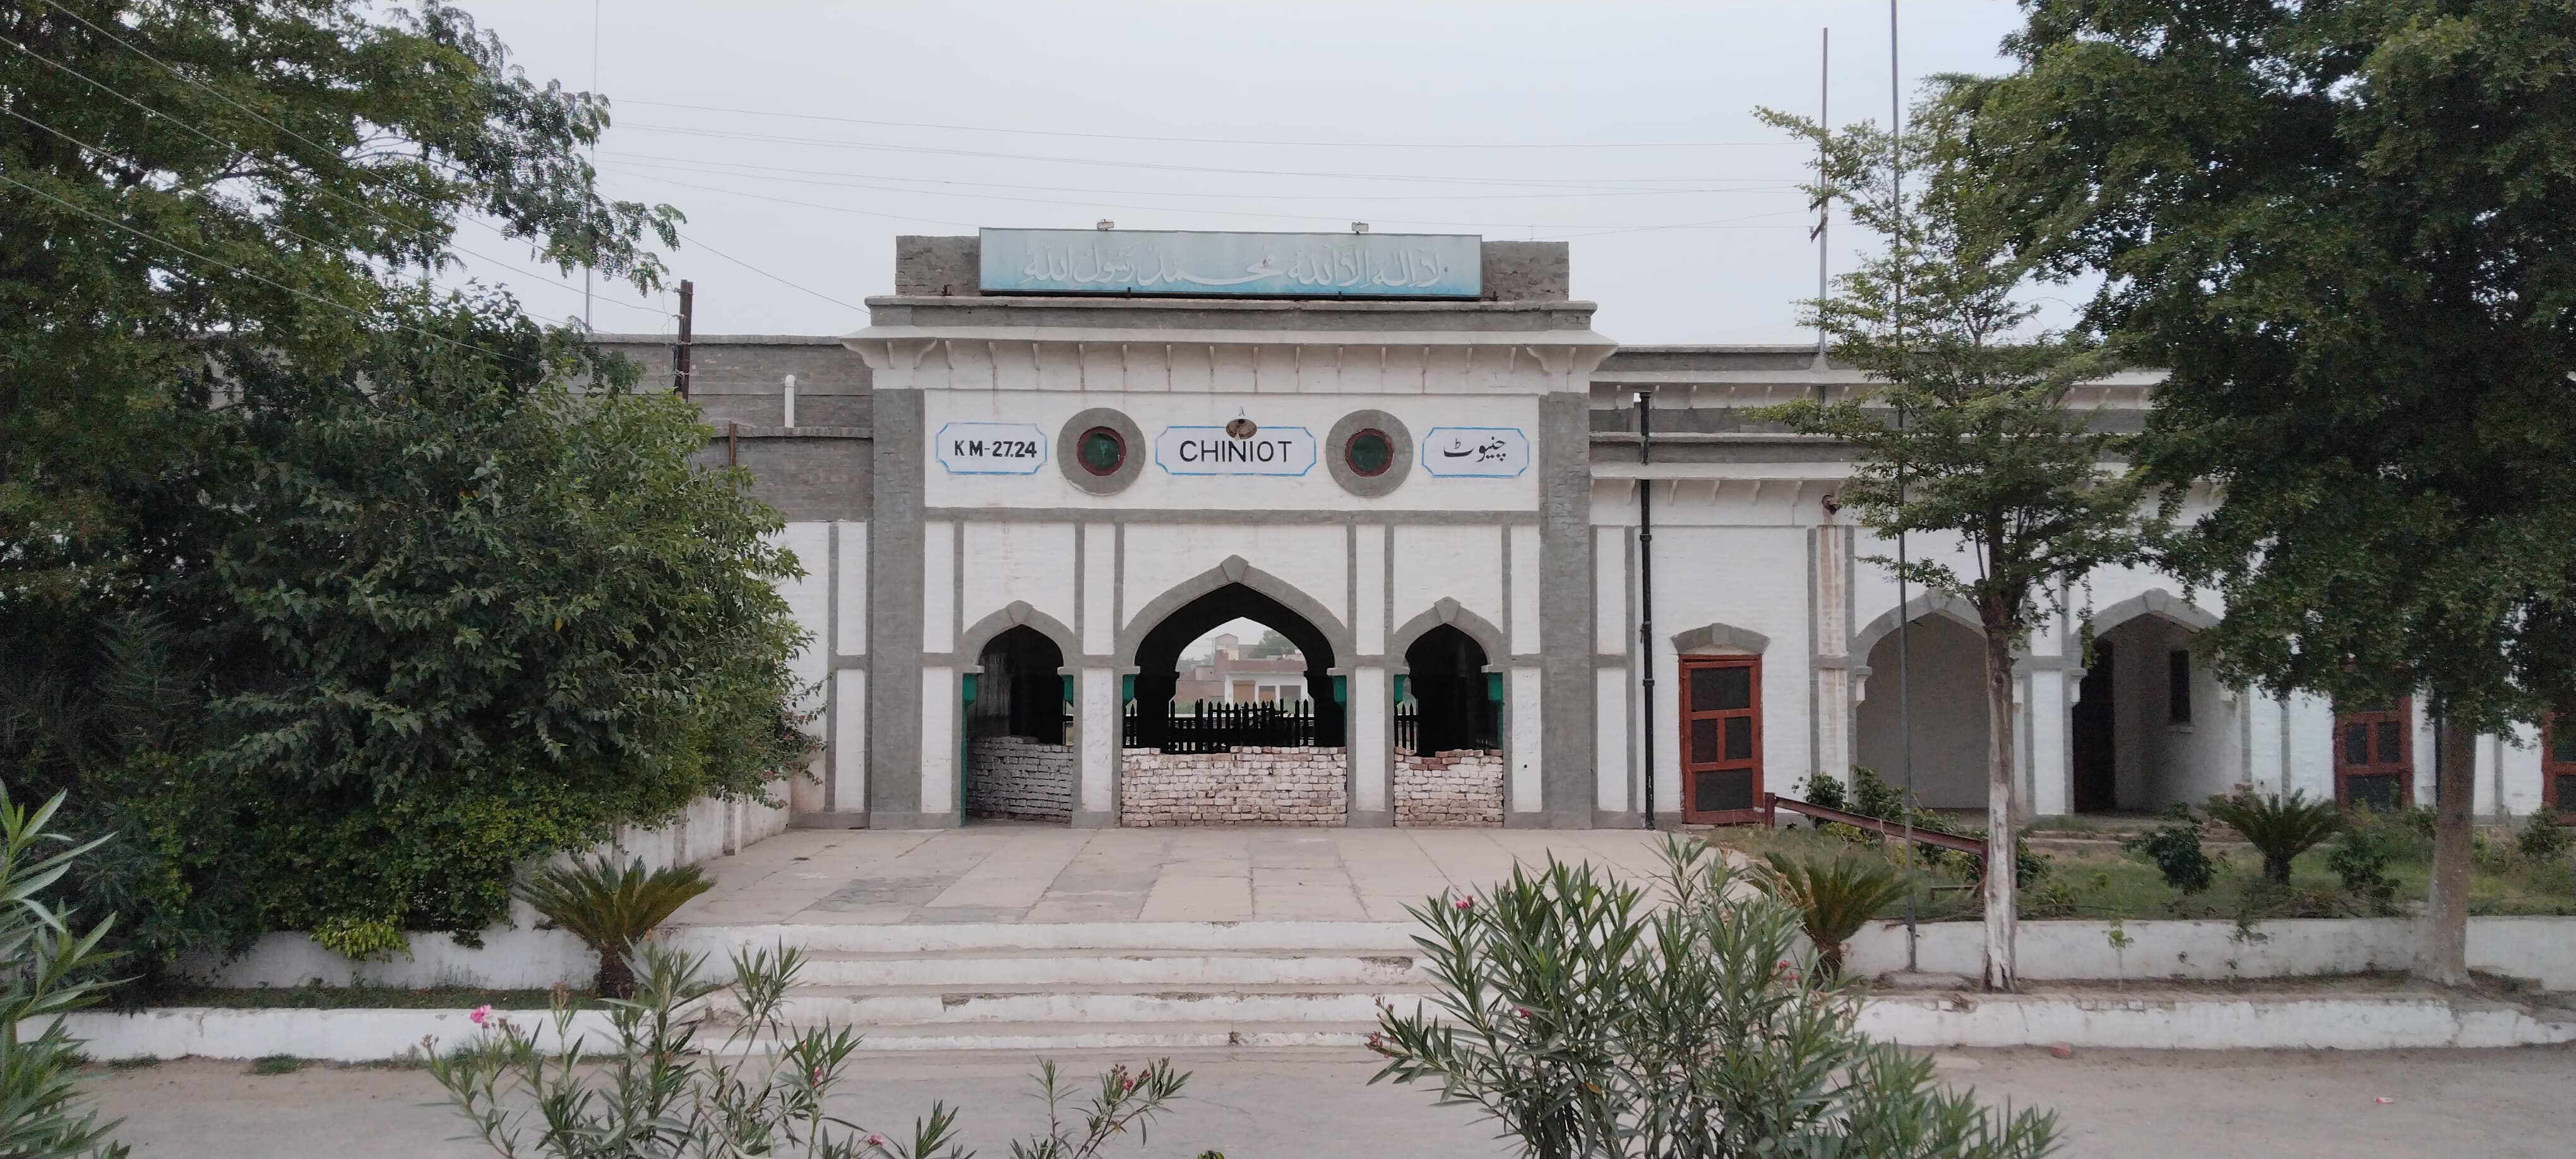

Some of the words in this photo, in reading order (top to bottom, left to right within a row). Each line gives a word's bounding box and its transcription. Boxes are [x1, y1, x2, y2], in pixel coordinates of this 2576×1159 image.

[1019, 241, 1073, 284] الله
[1073, 242, 1135, 284] رسول
[1136, 245, 1286, 286] محمد
[1179, 439, 1292, 463] CHINIOT
[1443, 436, 1506, 463] چنیوٹ
